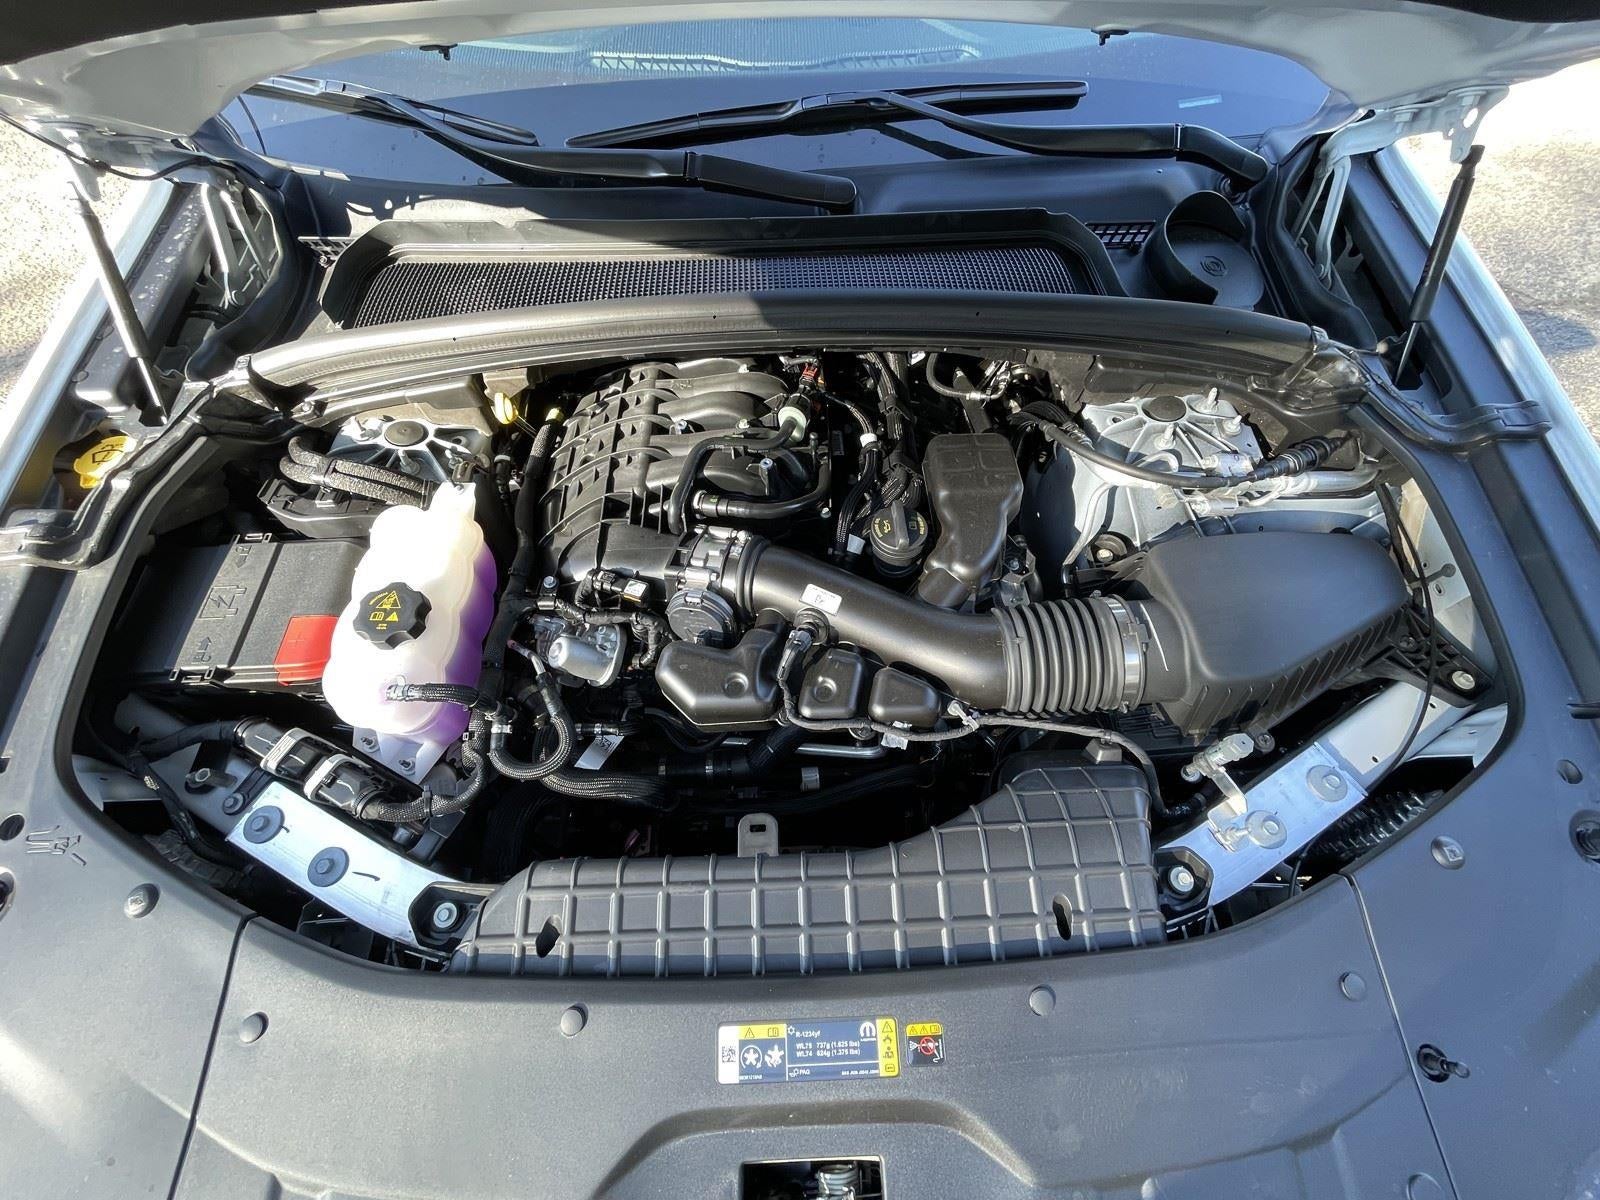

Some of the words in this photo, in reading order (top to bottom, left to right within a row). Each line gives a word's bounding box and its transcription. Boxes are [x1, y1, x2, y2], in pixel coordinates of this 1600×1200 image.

[795, 1030, 821, 1038] R-1234yf
[816, 1041, 830, 1049] 737g
[849, 1040, 860, 1048] lbs)
[796, 1050, 813, 1058] WL74
[849, 1048, 861, 1056] lbs)
